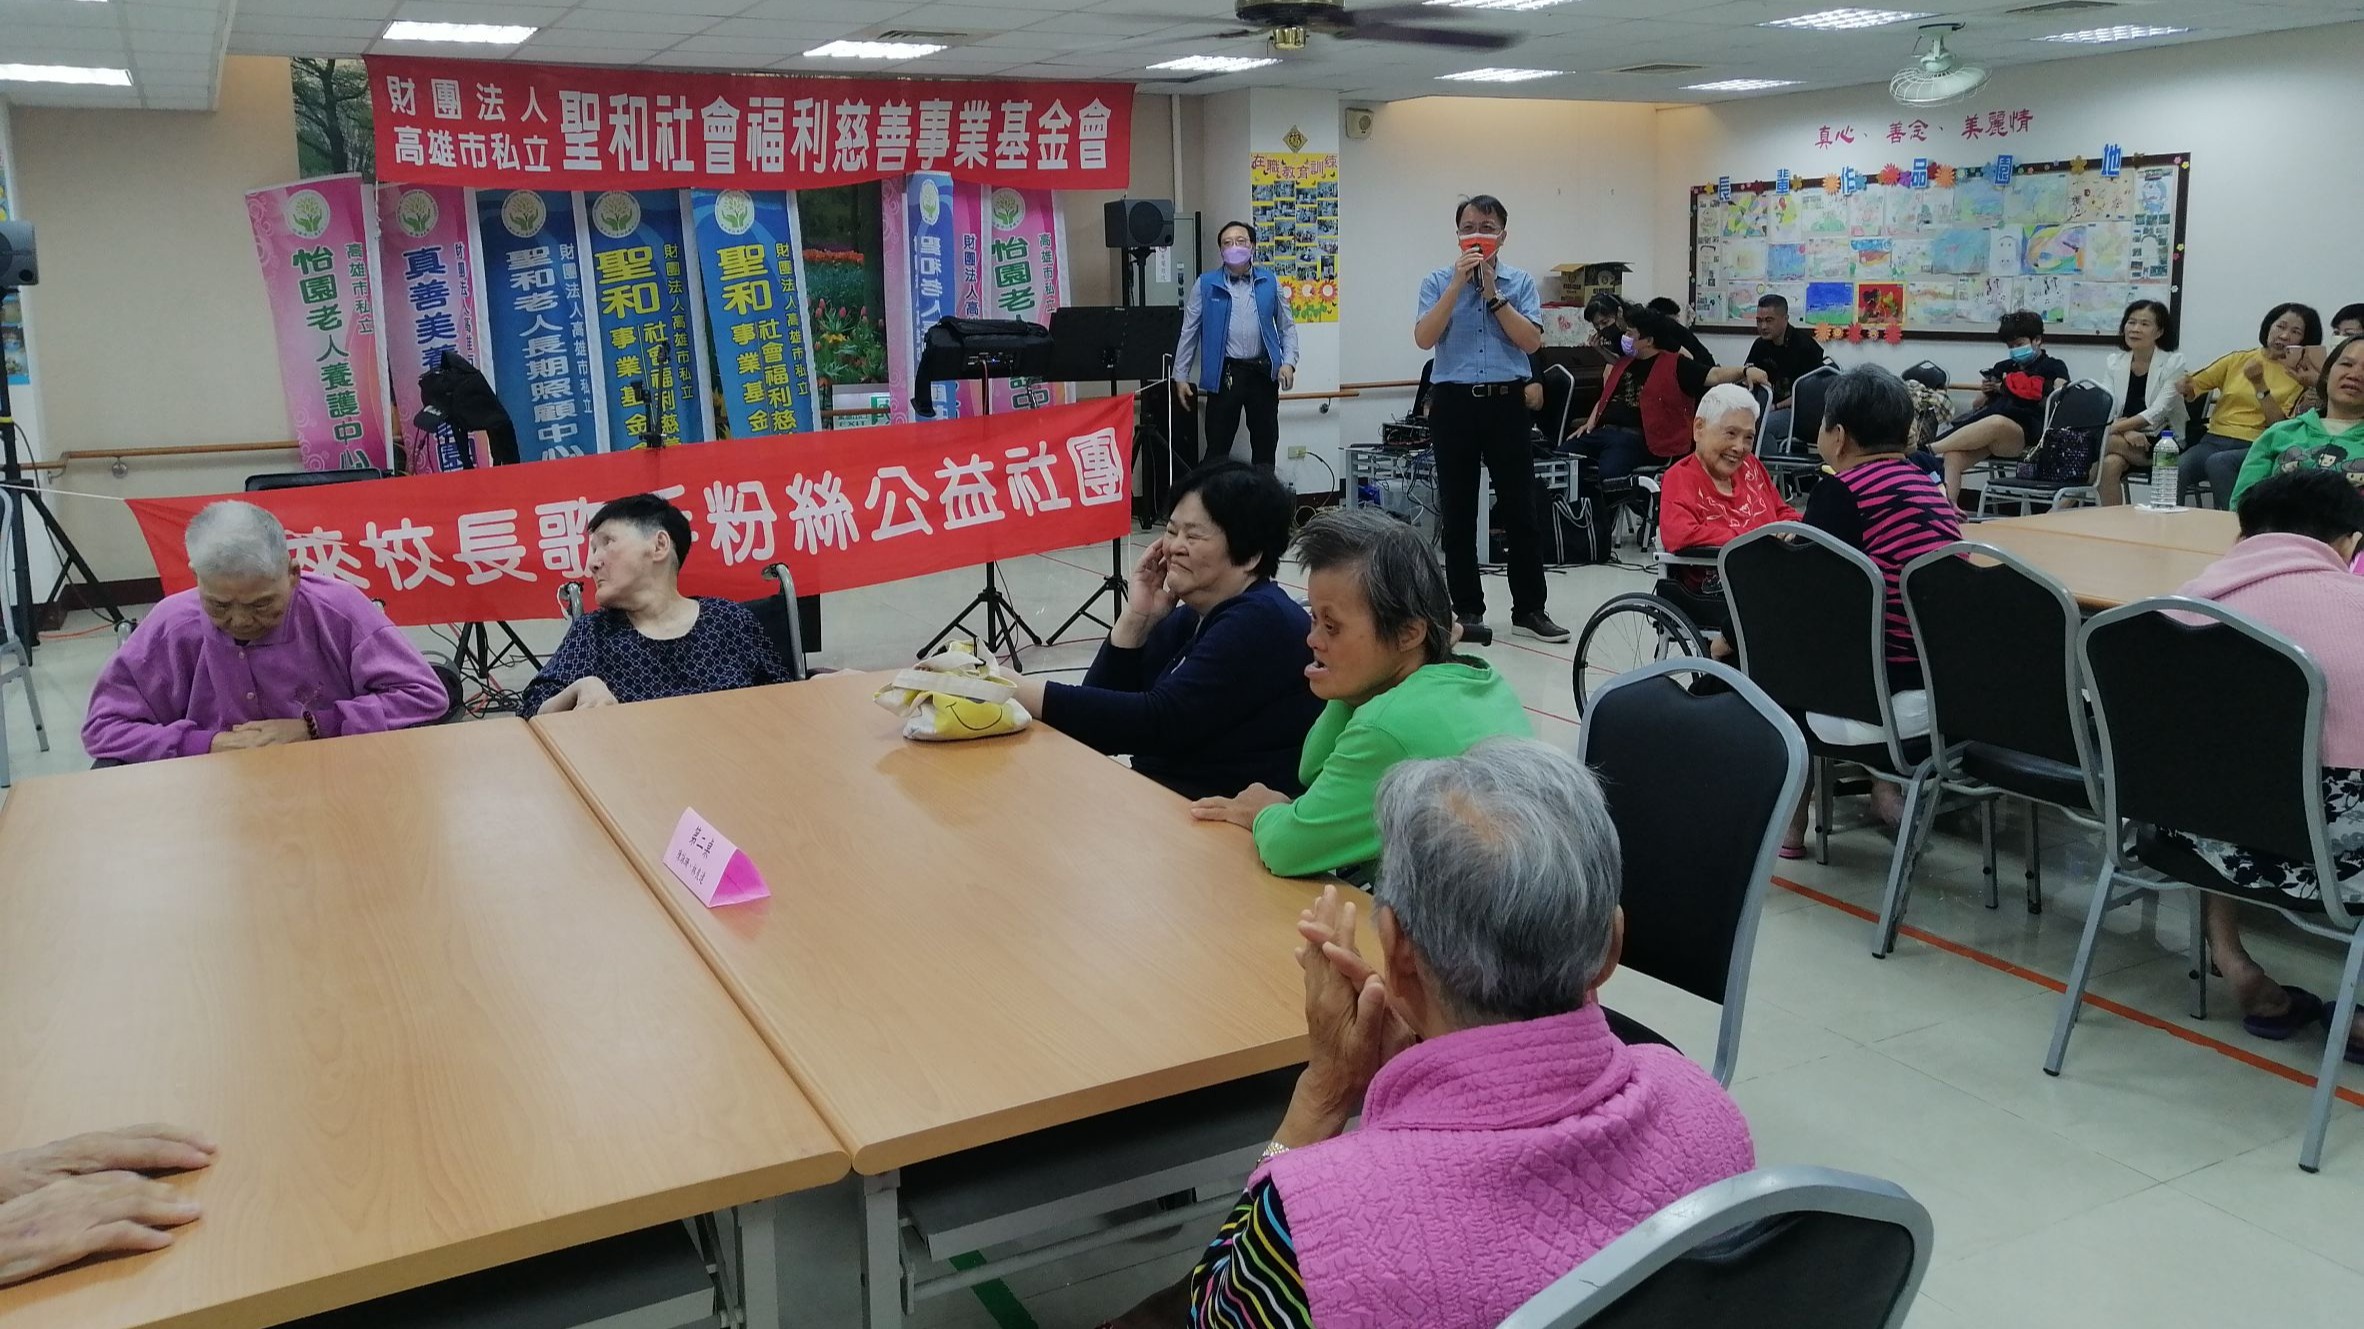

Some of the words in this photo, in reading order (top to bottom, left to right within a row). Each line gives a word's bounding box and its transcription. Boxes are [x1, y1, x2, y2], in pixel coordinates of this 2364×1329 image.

[386, 75, 549, 124] 財團法人
[558, 90, 1112, 175] 聖和社會福利慈善事業基金會
[394, 125, 551, 173] 高雄市私立
[1251, 154, 1338, 180] 在職教育訓練
[345, 242, 373, 334] 高雄市私立
[594, 246, 661, 319] 聖和
[717, 244, 773, 315] 聖和
[963, 234, 979, 319] 財團法人高
[992, 236, 1035, 320] 怡園老
[1040, 233, 1056, 312] 高雄市私立
[292, 245, 371, 469] 怡園老人養護中心
[506, 246, 584, 461] 聖和老人長期照顧中心
[560, 243, 593, 413] 財團法人高雄市私立
[664, 243, 694, 400] 財團法人高雄市私立
[775, 242, 809, 395] 財團法人高雄市私立
[610, 326, 648, 449] 事業基金
[731, 322, 770, 432] 事業基金
